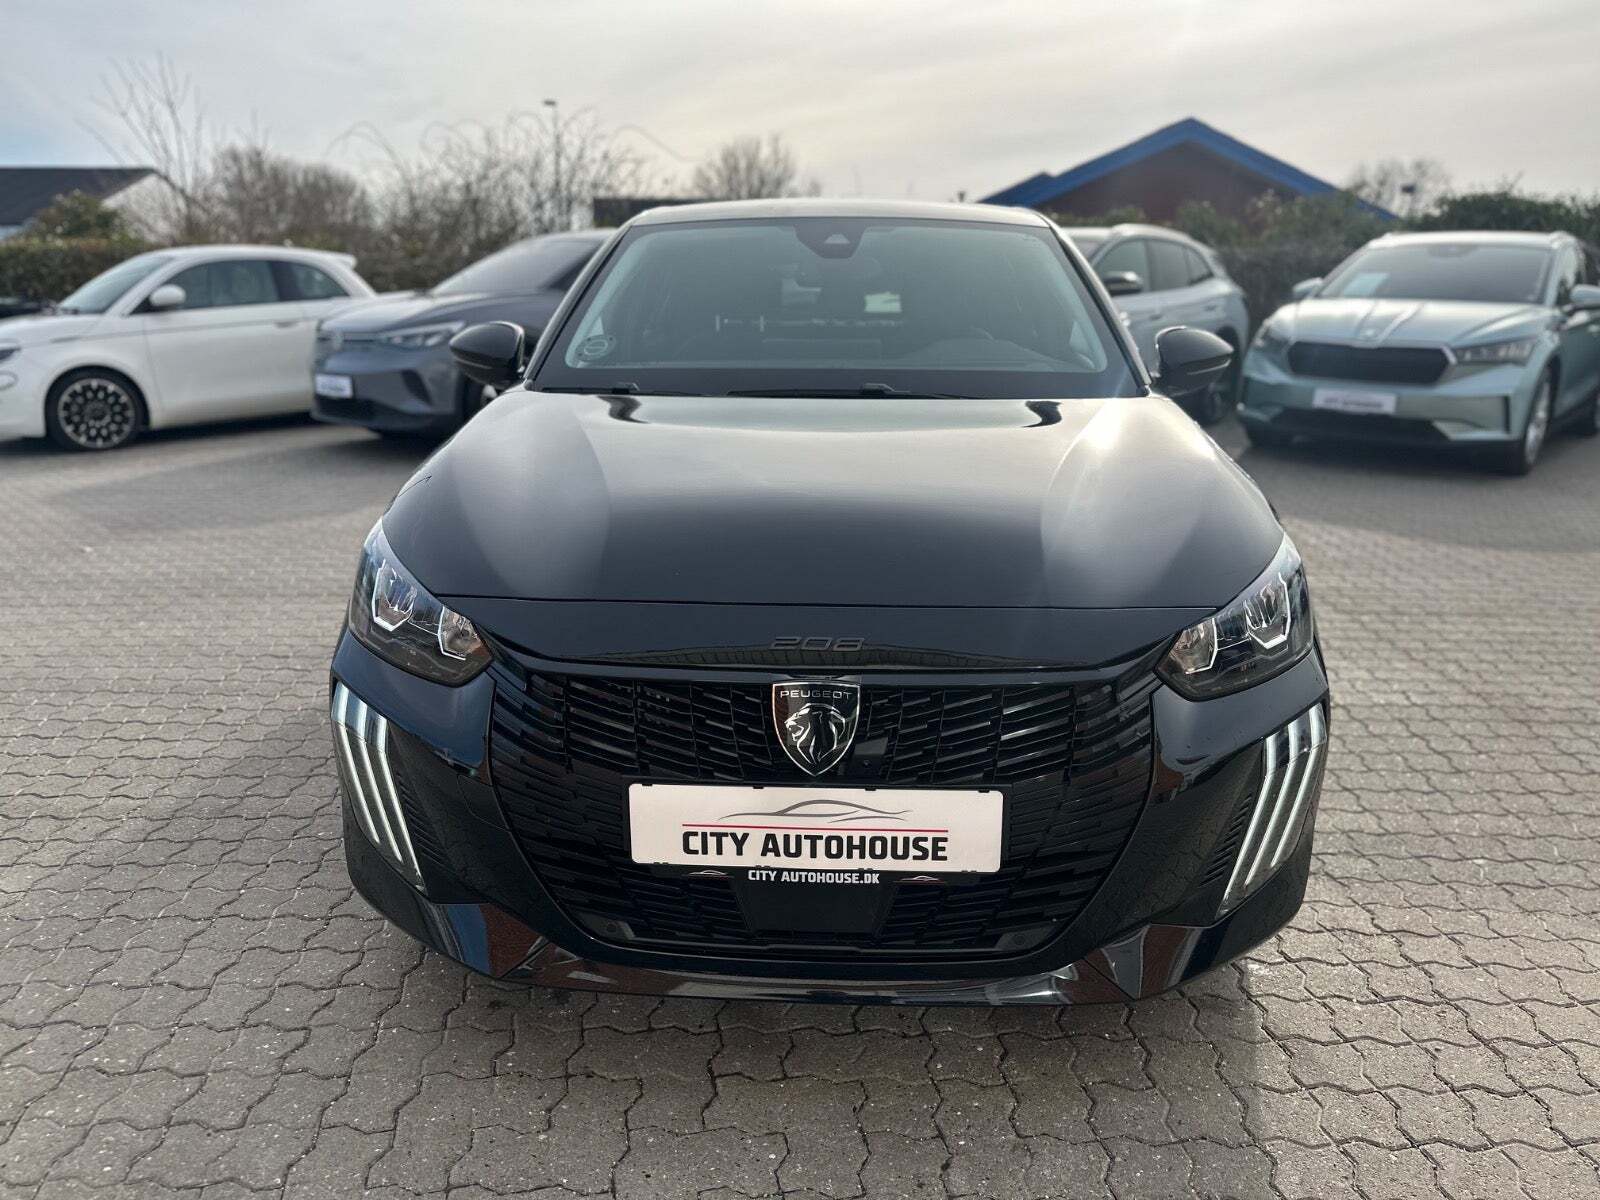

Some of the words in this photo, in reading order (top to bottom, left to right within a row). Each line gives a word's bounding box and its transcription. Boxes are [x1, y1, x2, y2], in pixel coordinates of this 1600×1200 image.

[769, 636, 865, 652] 208
[780, 690, 852, 700] PEUGEOT
[682, 831, 750, 857] CITY
[760, 833, 949, 862] AUTOHOUSE
[748, 869, 777, 882] CITY
[781, 871, 880, 885] AUTOHOUSE.DK
